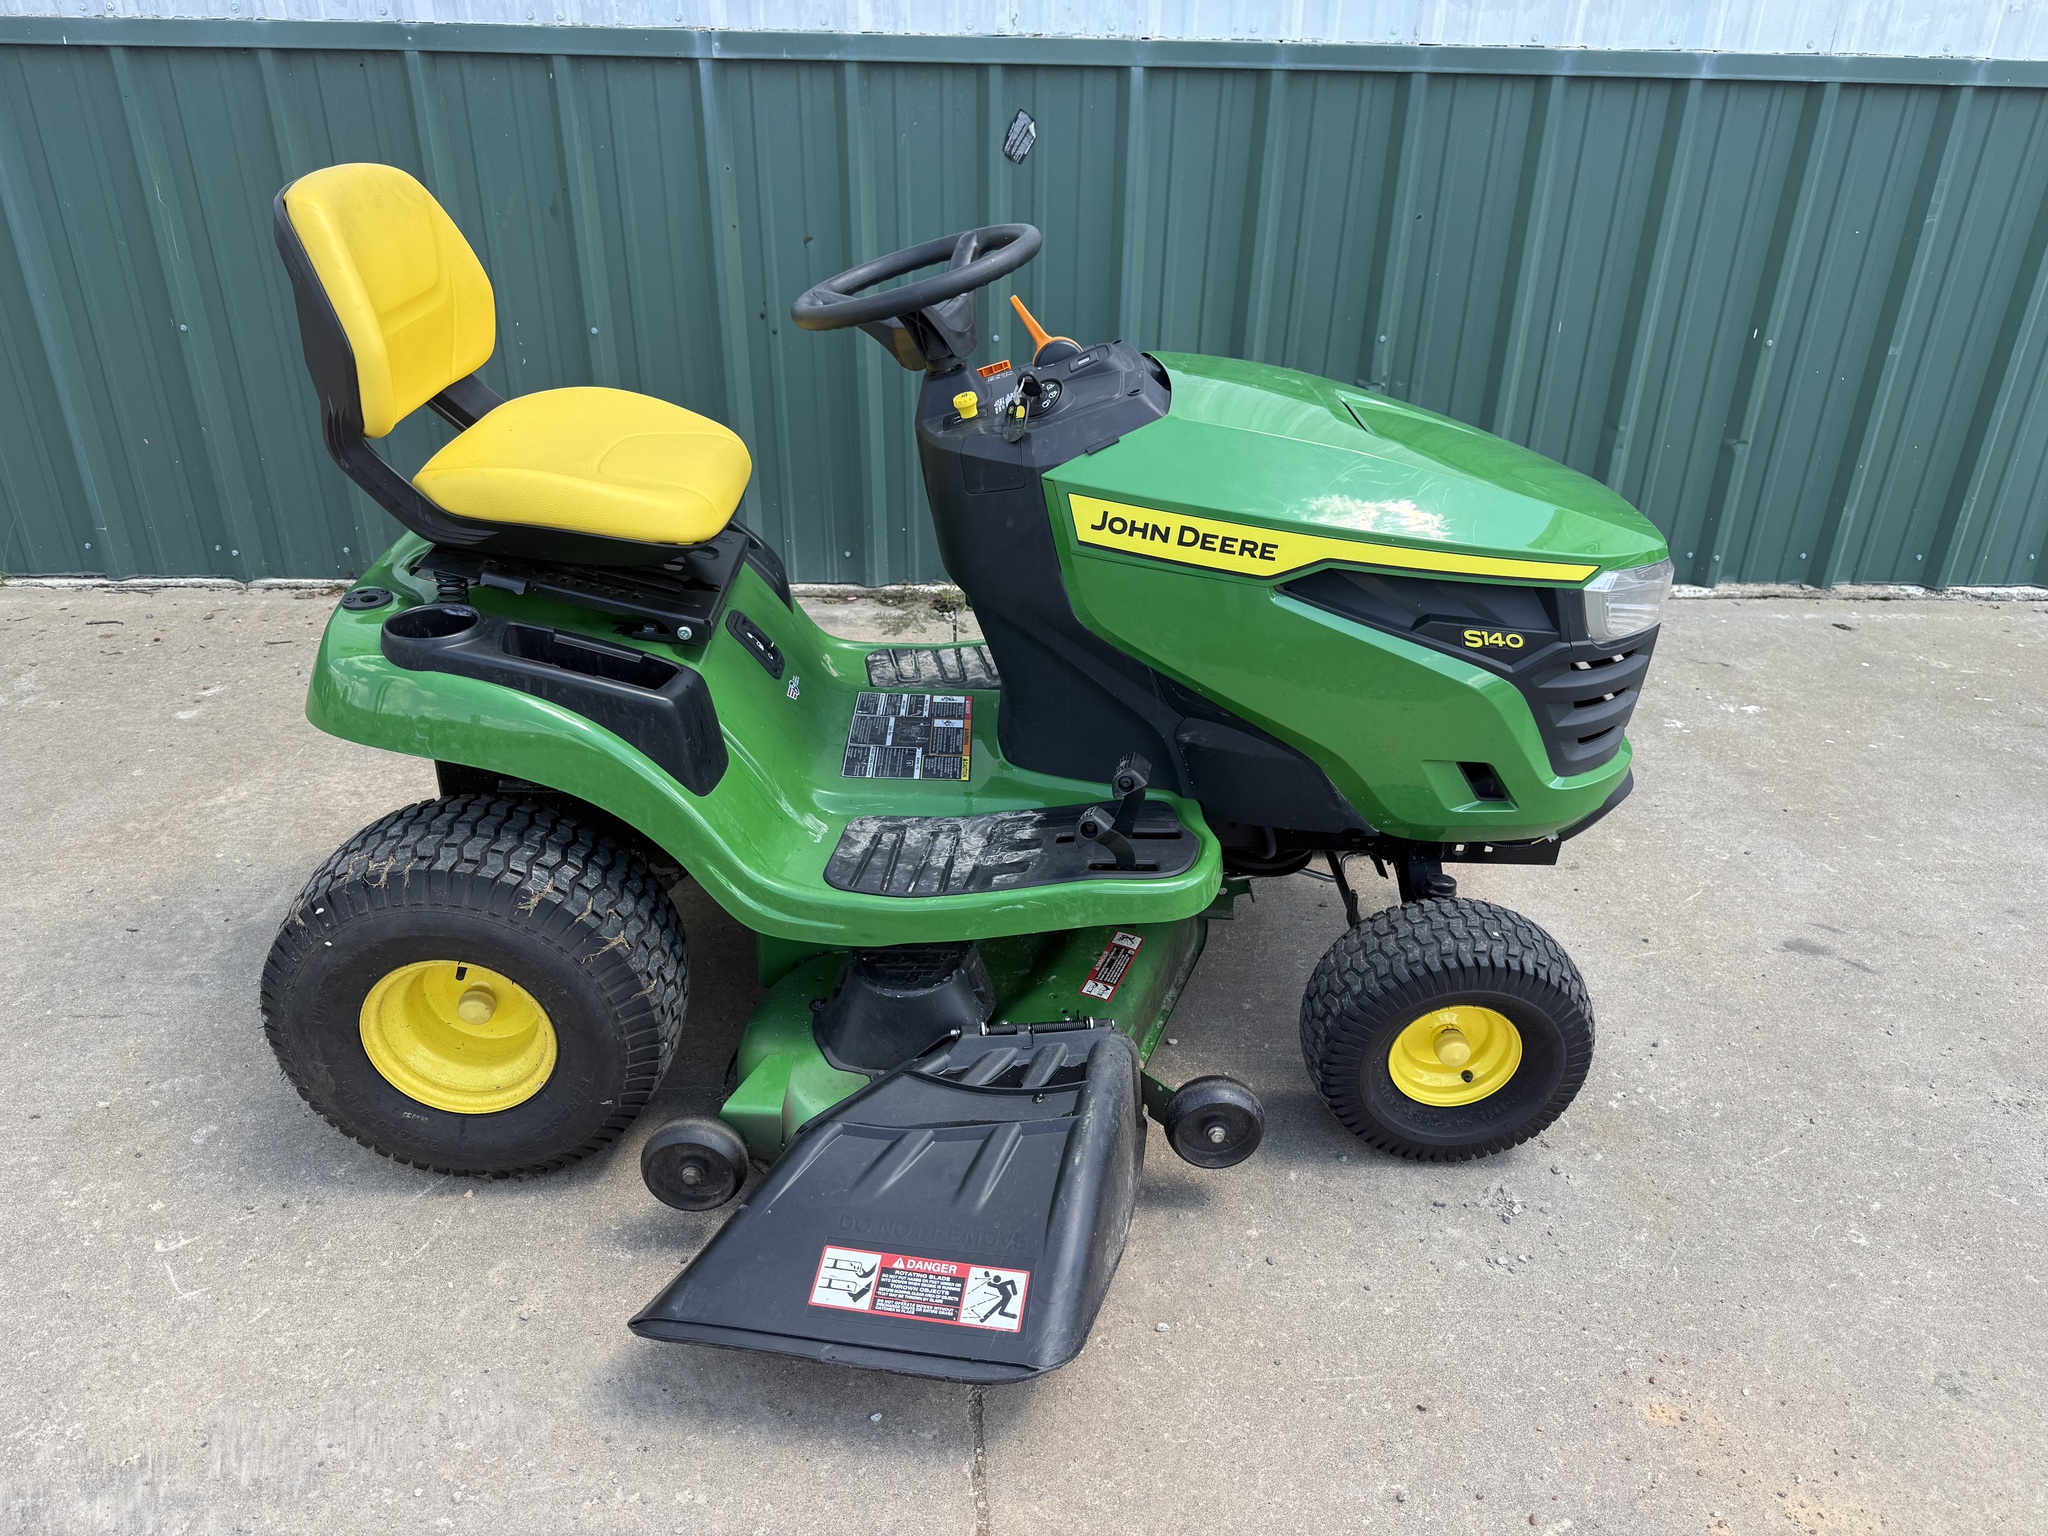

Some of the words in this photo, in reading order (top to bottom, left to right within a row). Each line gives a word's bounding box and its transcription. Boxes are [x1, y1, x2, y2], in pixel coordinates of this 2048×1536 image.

[1090, 511, 1171, 543] JOHN
[1176, 525, 1279, 561] DEERE
[1463, 629, 1524, 649] S140
[839, 1214, 872, 1233] DO
[878, 1218, 924, 1239] NOT
[894, 1270, 928, 1279] ROTATING
[906, 1259, 958, 1275] DANGER
[890, 1283, 918, 1292] THROWN
[919, 1288, 950, 1296] OBJECTS
